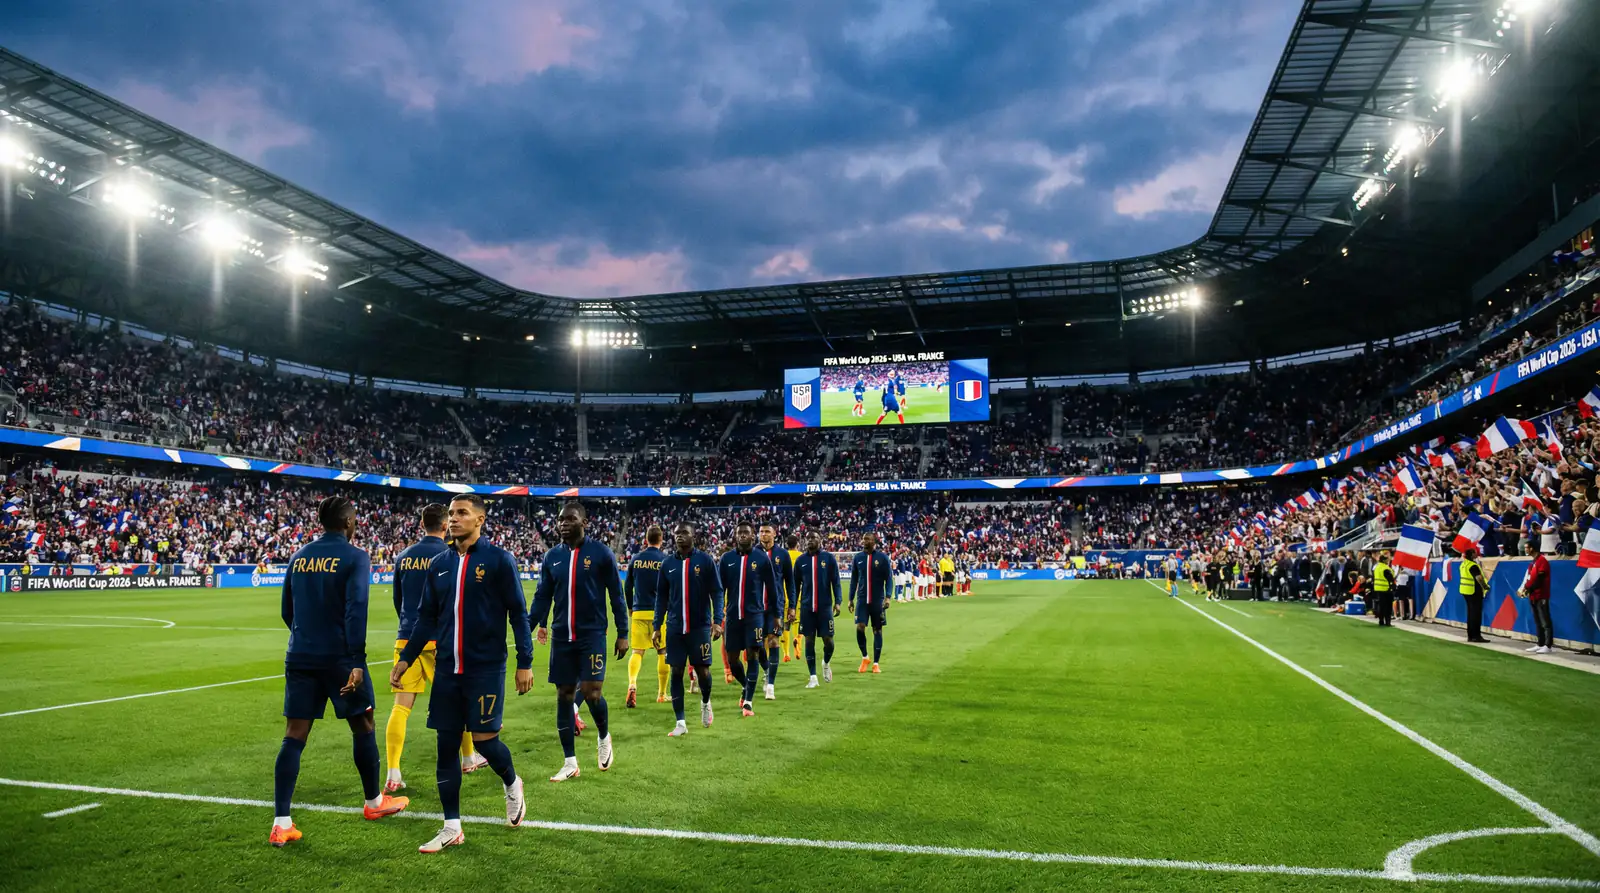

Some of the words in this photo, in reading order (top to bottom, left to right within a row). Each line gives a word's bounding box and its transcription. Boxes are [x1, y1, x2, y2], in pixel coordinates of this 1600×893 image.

[823, 357, 838, 366] FIFA
[838, 356, 857, 365] World
[858, 356, 870, 365] Cup
[892, 354, 906, 362] USA
[917, 352, 944, 361] FRANCE
[1517, 361, 1531, 378] FIFA
[1547, 350, 1559, 366] Cup
[1559, 338, 1577, 359] 2026
[1581, 328, 1597, 349] USA
[793, 385, 810, 396] USA
[806, 484, 820, 492] FIFA
[840, 483, 852, 492] Cup
[875, 482, 889, 490] USA
[900, 482, 927, 490] FRANCE
[292, 556, 341, 574] FRANCE
[633, 559, 662, 571] FRANCE
[28, 578, 51, 589] FIFA
[88, 577, 108, 590] Cup
[108, 577, 131, 588] 2026
[137, 577, 156, 587] USA
[156, 578, 168, 587] vs.
[169, 576, 201, 586] FRANCE
[699, 643, 711, 657] 12
[588, 654, 604, 670] 15
[477, 694, 497, 716] 17
